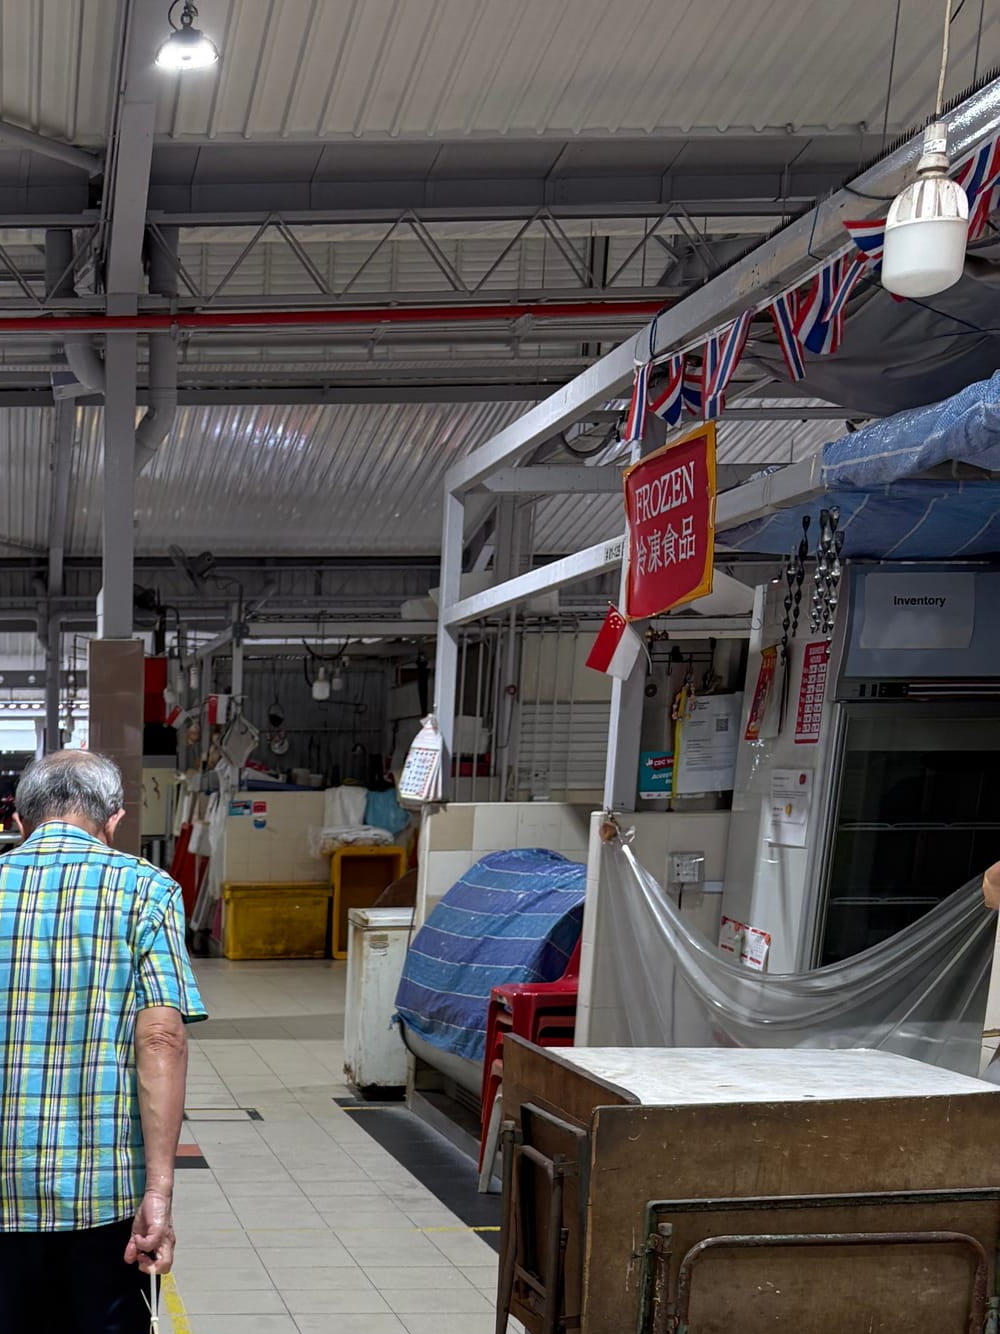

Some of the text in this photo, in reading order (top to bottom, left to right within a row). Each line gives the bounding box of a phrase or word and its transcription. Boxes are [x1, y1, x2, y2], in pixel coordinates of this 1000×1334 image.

[634, 460, 695, 526] FROZEN
[635, 514, 696, 577] 冷凍食品
[893, 595, 947, 608] Inventory
